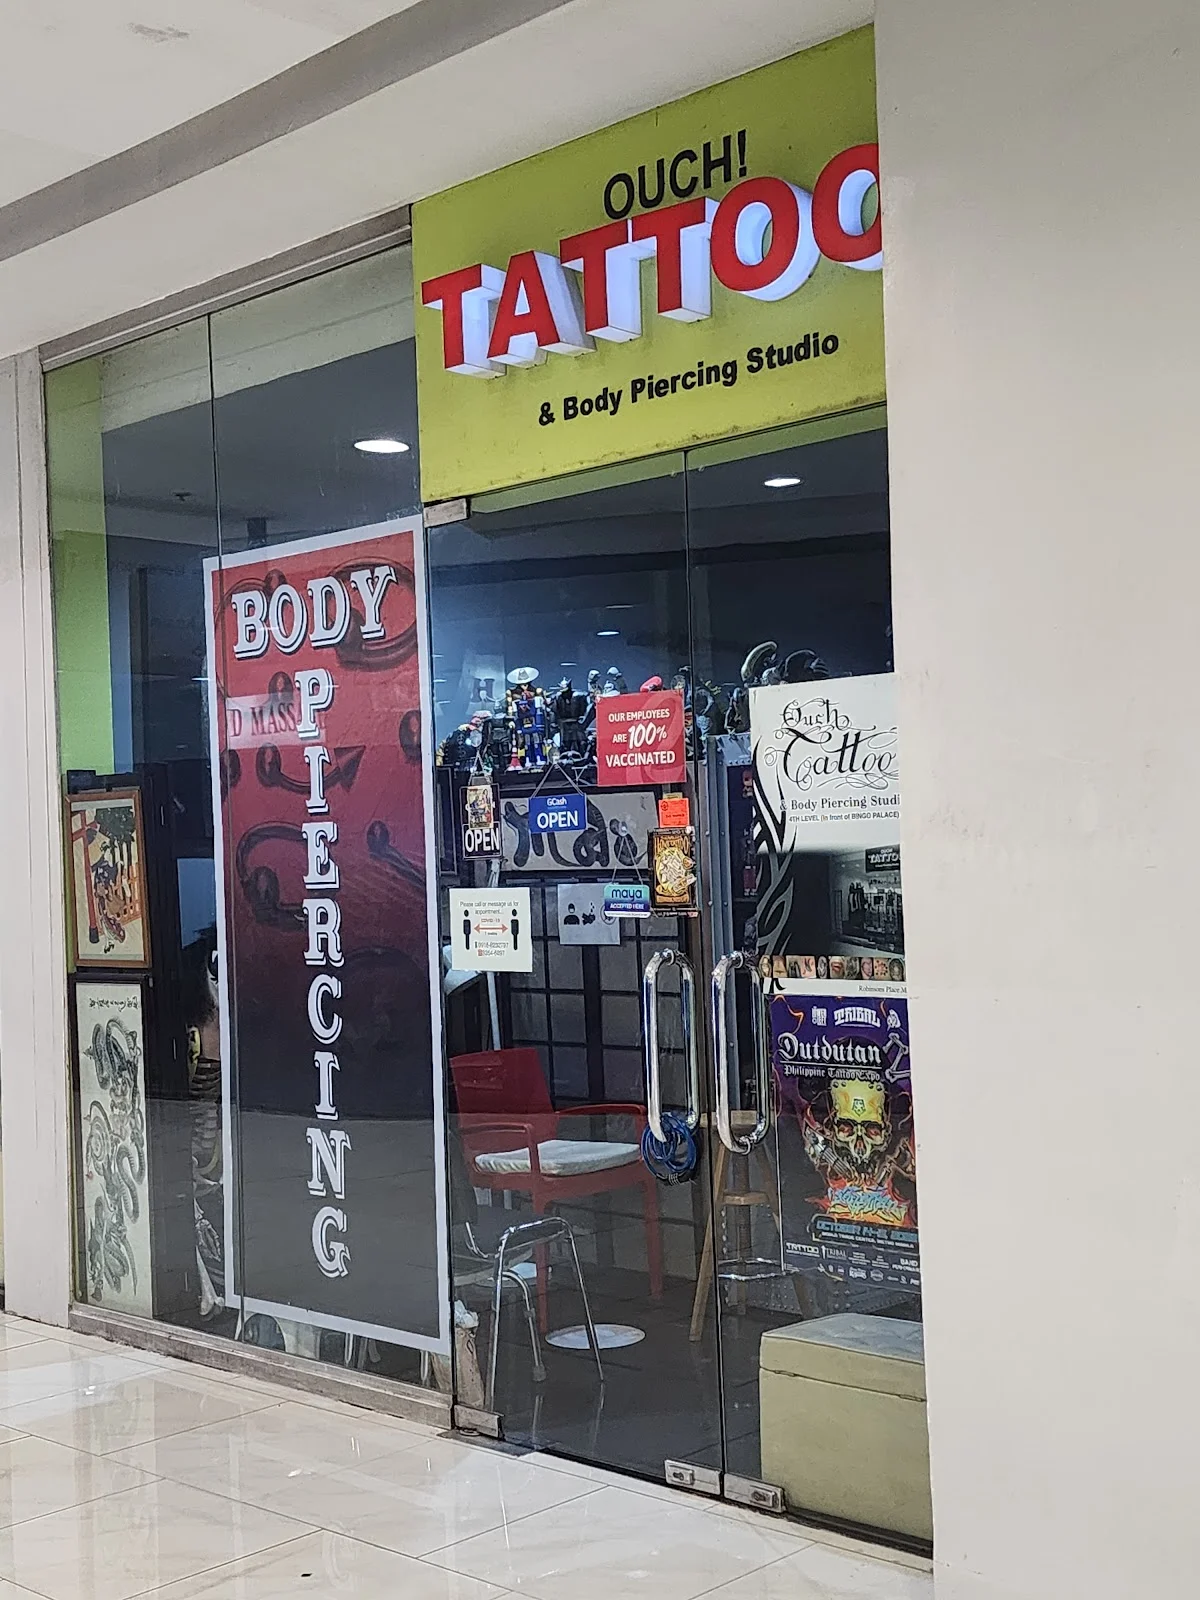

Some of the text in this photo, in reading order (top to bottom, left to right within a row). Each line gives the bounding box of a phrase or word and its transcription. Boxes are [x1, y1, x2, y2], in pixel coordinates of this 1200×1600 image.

[603, 129, 748, 220] OUCH!
[538, 332, 840, 426] & Body Piercing Studio
[231, 566, 398, 659] BODY
[608, 708, 670, 723] OUR EMPLOYEES
[779, 698, 860, 731] Ouch
[612, 722, 667, 749] ARE 100%
[605, 751, 676, 767] VACCINATED
[764, 728, 899, 790] Tattoo
[546, 797, 568, 806] GCash
[790, 800, 818, 812] Body
[821, 795, 868, 809] Piercing
[870, 793, 901, 806] Studi
[537, 810, 579, 829] OPEN
[801, 814, 819, 822] LEVEL
[829, 813, 844, 821] front
[844, 813, 851, 821] of
[852, 811, 872, 820] BINGO
[872, 810, 900, 820] PALACE)
[464, 827, 501, 853] OPEN
[868, 852, 899, 864] TATTO
[611, 889, 643, 901] maya
[295, 669, 352, 1279] PIERCING
[858, 985, 885, 993] Robinsons
[885, 986, 900, 994] Place
[834, 1006, 881, 1028] TRIBAL
[778, 1032, 882, 1064] Dutdutan
[784, 1065, 881, 1081] Philippine Tattoo Expo
[786, 1242, 820, 1254] TATTOO
